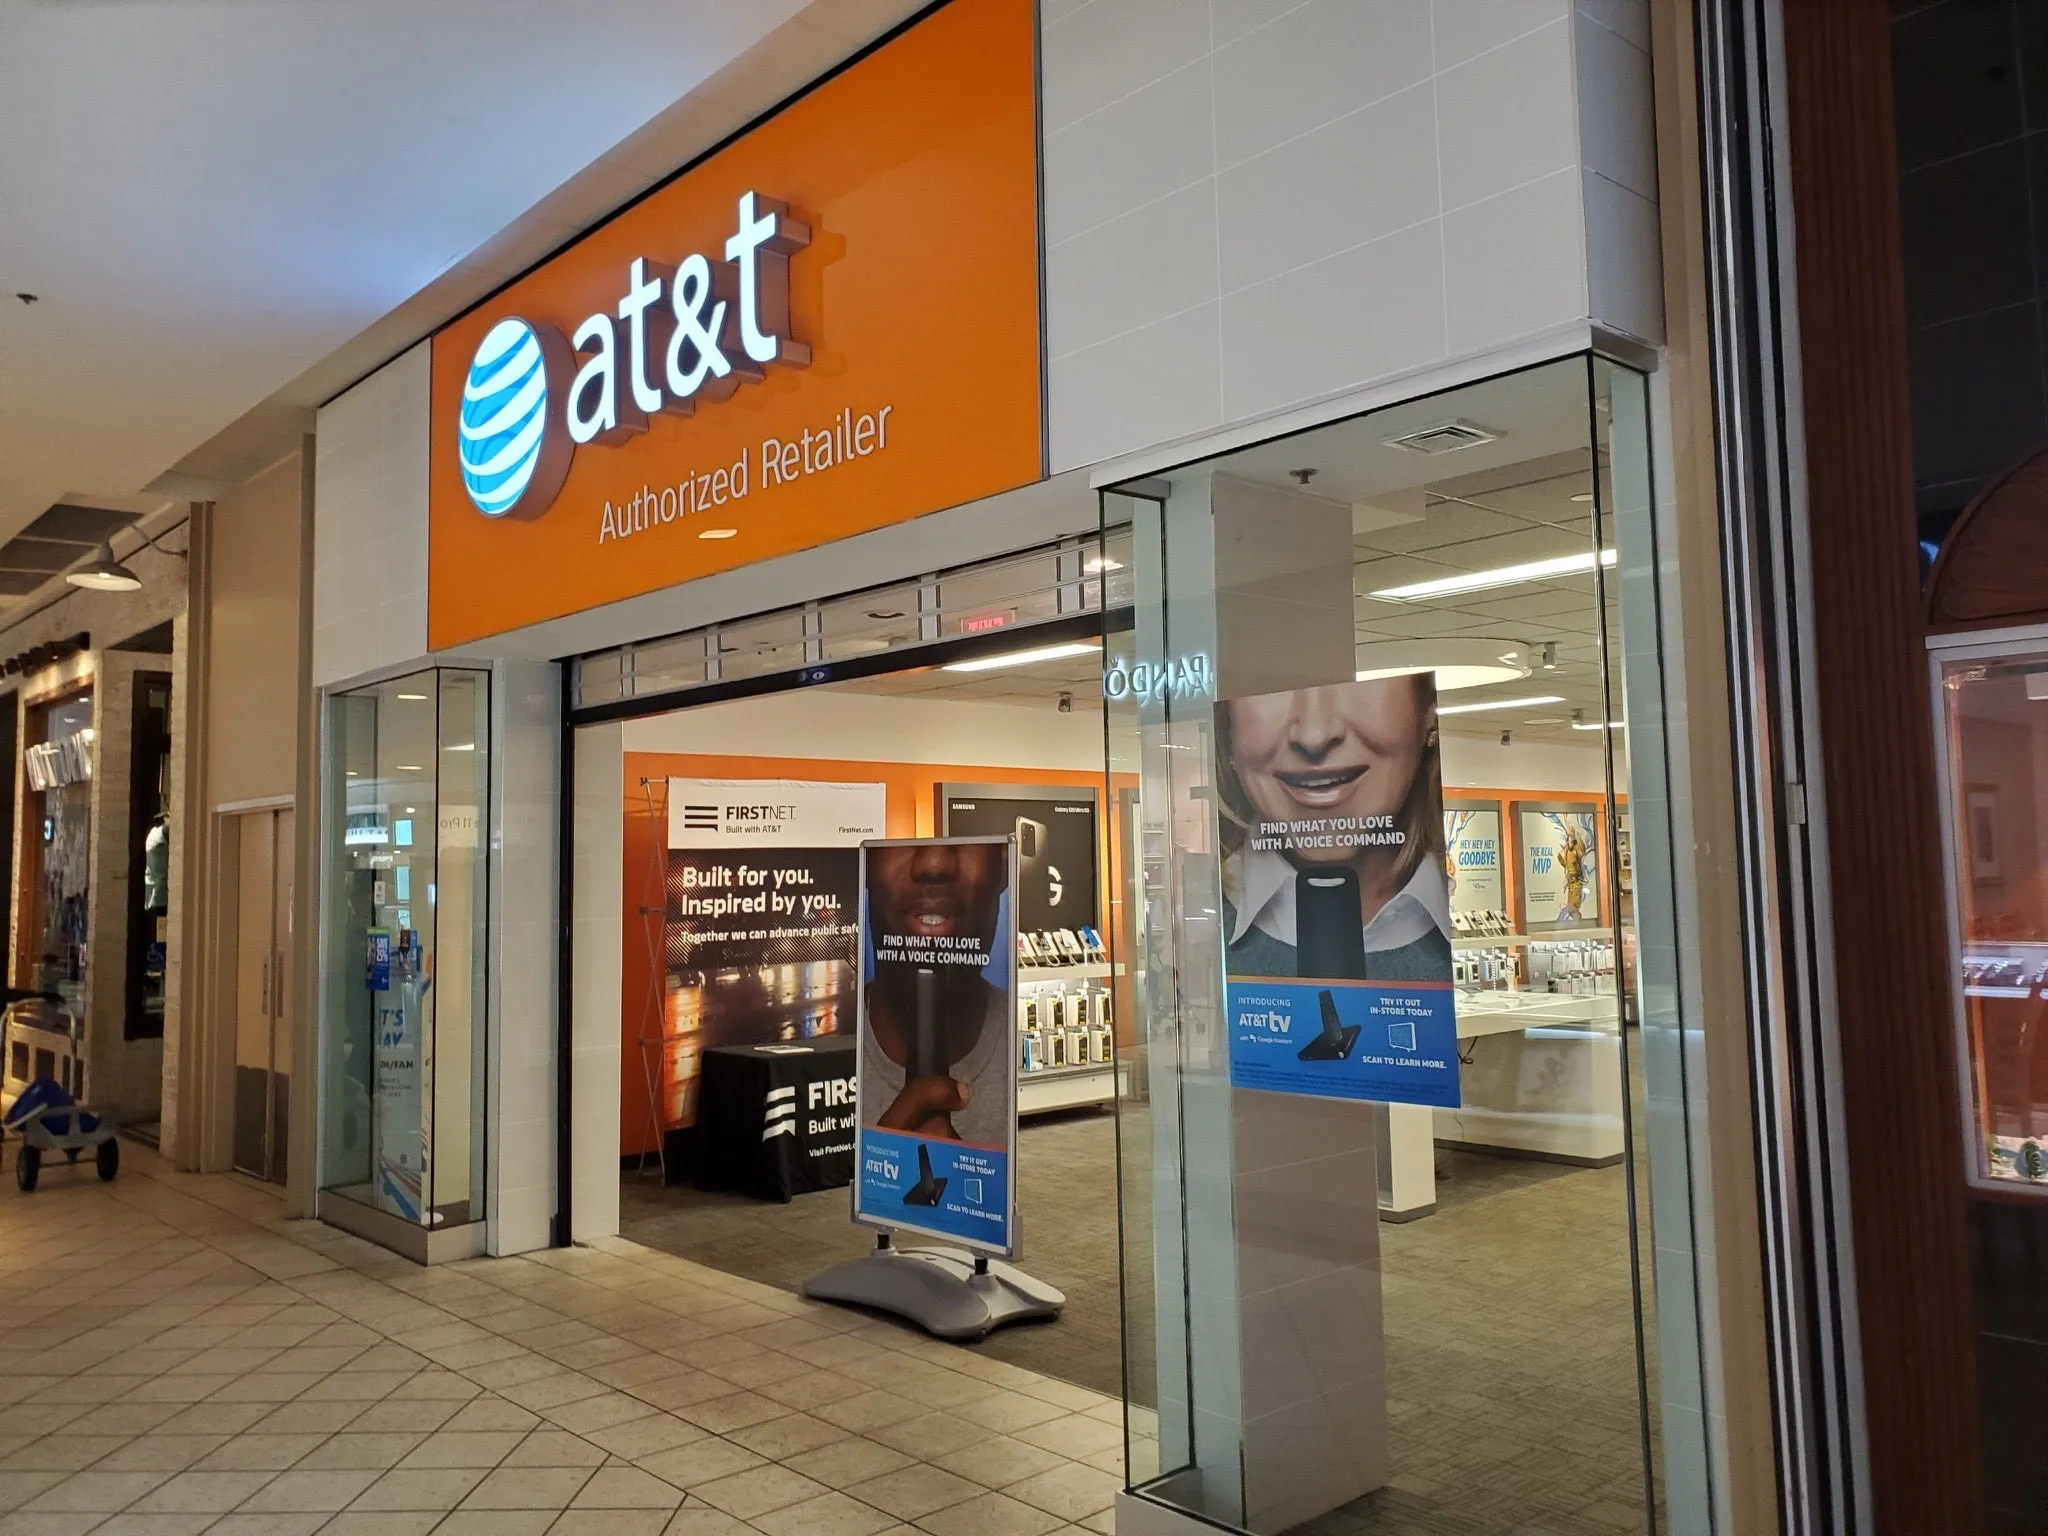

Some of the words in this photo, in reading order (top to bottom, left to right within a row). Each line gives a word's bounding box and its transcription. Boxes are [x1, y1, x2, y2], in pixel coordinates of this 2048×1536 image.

[567, 190, 777, 443] at&t
[599, 448, 748, 544] Authorized
[762, 405, 893, 488] Retailer
[726, 825, 743, 834] Built
[745, 825, 760, 834] with
[762, 825, 782, 833] AT&T
[1260, 822, 1288, 835] FIND
[1290, 819, 1327, 833] WHAT
[1329, 817, 1356, 831] YOU
[1358, 815, 1393, 830] LOVE
[1251, 837, 1282, 850] WITH
[1284, 837, 1293, 849] A
[1296, 834, 1333, 849] VOICE
[1336, 831, 1406, 847] COMMAND
[1460, 840, 1471, 849] HEY
[1472, 840, 1483, 849] HEY
[1484, 840, 1495, 849] HEY
[1458, 851, 1496, 865] GOODBYE
[1530, 847, 1540, 856] THE
[1541, 847, 1553, 856] REAL
[1532, 858, 1551, 874] MVP
[682, 865, 732, 888] Built
[737, 865, 768, 887] for
[773, 867, 814, 889] you.
[682, 891, 766, 918] Inspired
[772, 891, 796, 915] by
[802, 893, 842, 916] you.
[681, 930, 729, 945] Together
[731, 932, 747, 940] we
[749, 930, 767, 940] can
[769, 927, 810, 938] advance
[811, 924, 840, 938] public
[883, 934, 903, 947] FIND
[905, 935, 931, 948] WHAT
[934, 936, 955, 949] YOU
[955, 937, 981, 950] LOVE
[876, 949, 899, 961] WITH
[899, 950, 907, 962] A
[907, 950, 935, 963] VOICE
[937, 951, 990, 966] COMMAND
[1237, 996, 1291, 1007] INTRODUCING
[1380, 997, 1394, 1005] TRY
[1396, 998, 1404, 1006] IT
[1405, 999, 1421, 1007] OUT
[1370, 1006, 1405, 1016] IN-STORE
[1406, 1008, 1433, 1017] TODAY
[1239, 1013, 1268, 1028] AT&T
[1362, 1056, 1382, 1064] SCAN
[1383, 1057, 1394, 1065] TO
[1395, 1058, 1420, 1067] LEARN
[1422, 1060, 1447, 1069] MORE.
[808, 1116, 837, 1135] Built
[840, 1112, 857, 1129] wi
[808, 1147, 825, 1158] Visit
[866, 1159, 883, 1173] AT&T
[976, 1166, 996, 1176] TODAY
[961, 1206, 969, 1214] TO
